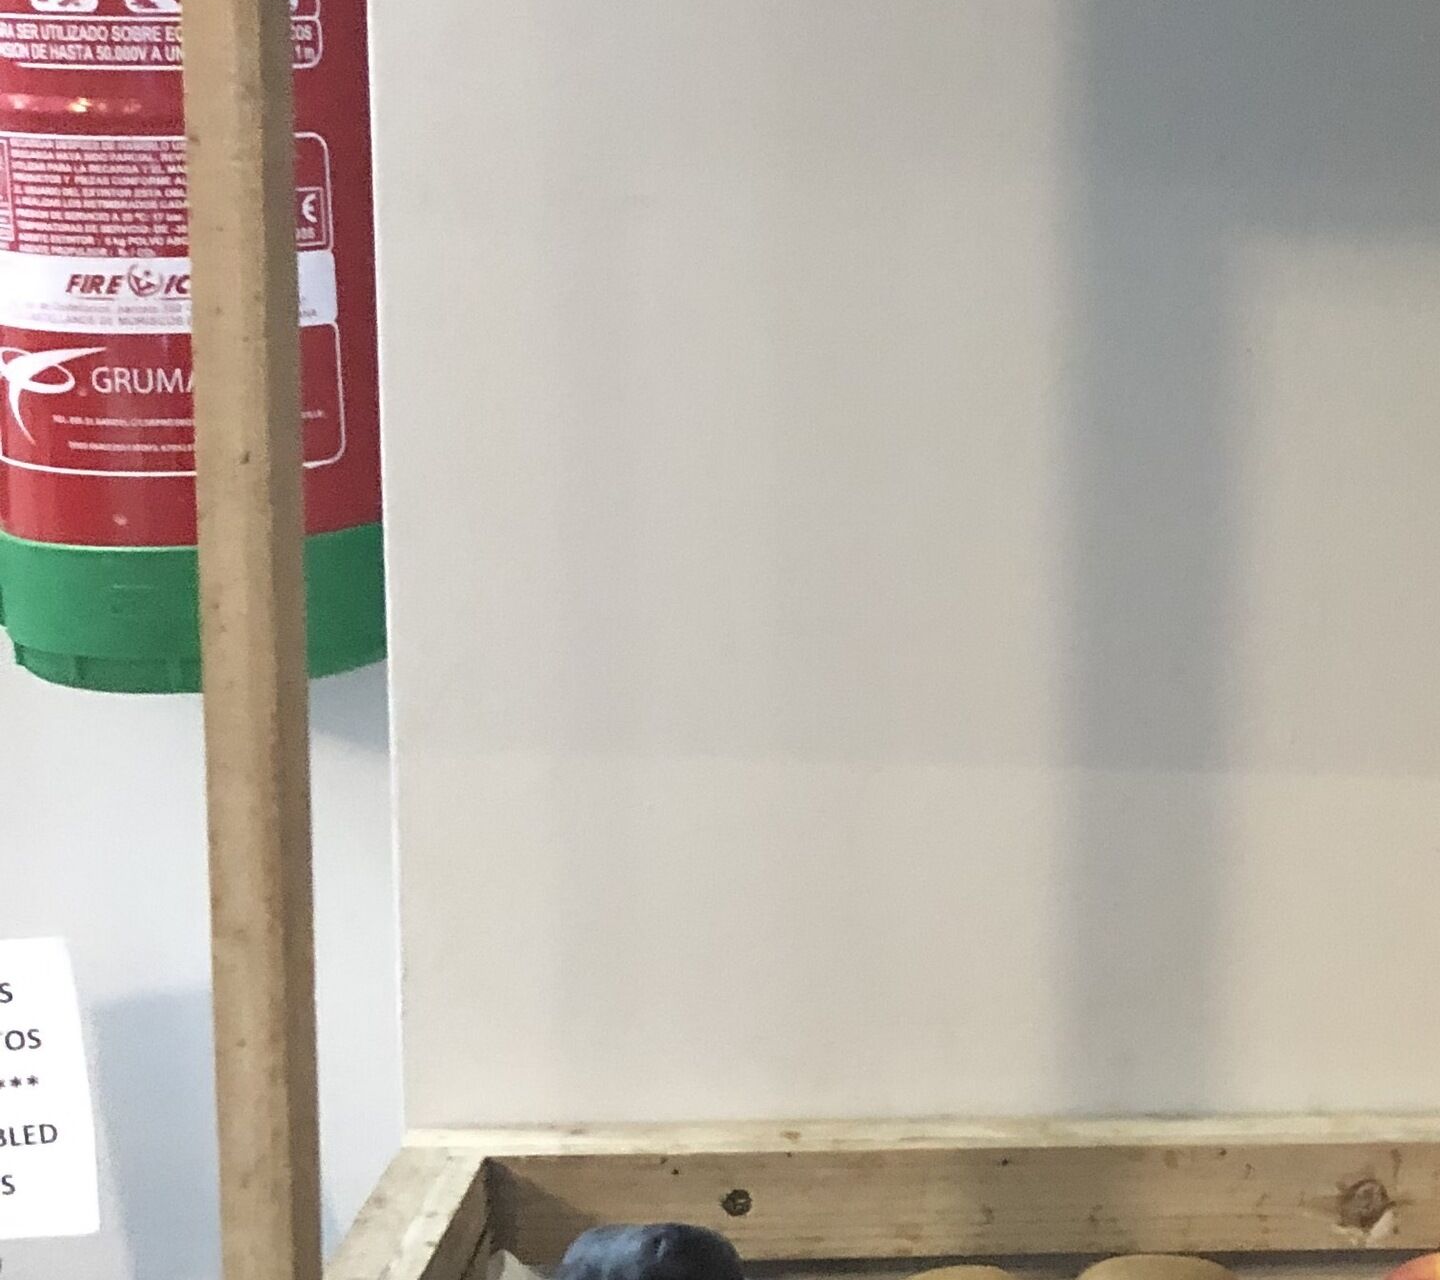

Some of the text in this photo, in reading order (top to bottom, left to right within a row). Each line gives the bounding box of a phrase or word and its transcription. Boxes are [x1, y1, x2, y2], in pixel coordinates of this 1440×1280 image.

[111, 25, 161, 42] SOBRE
[31, 43, 48, 59] DE
[50, 45, 94, 60] HASTA
[151, 46, 162, 61] A
[65, 273, 123, 295] FIRE
[91, 367, 193, 394] GRUM
